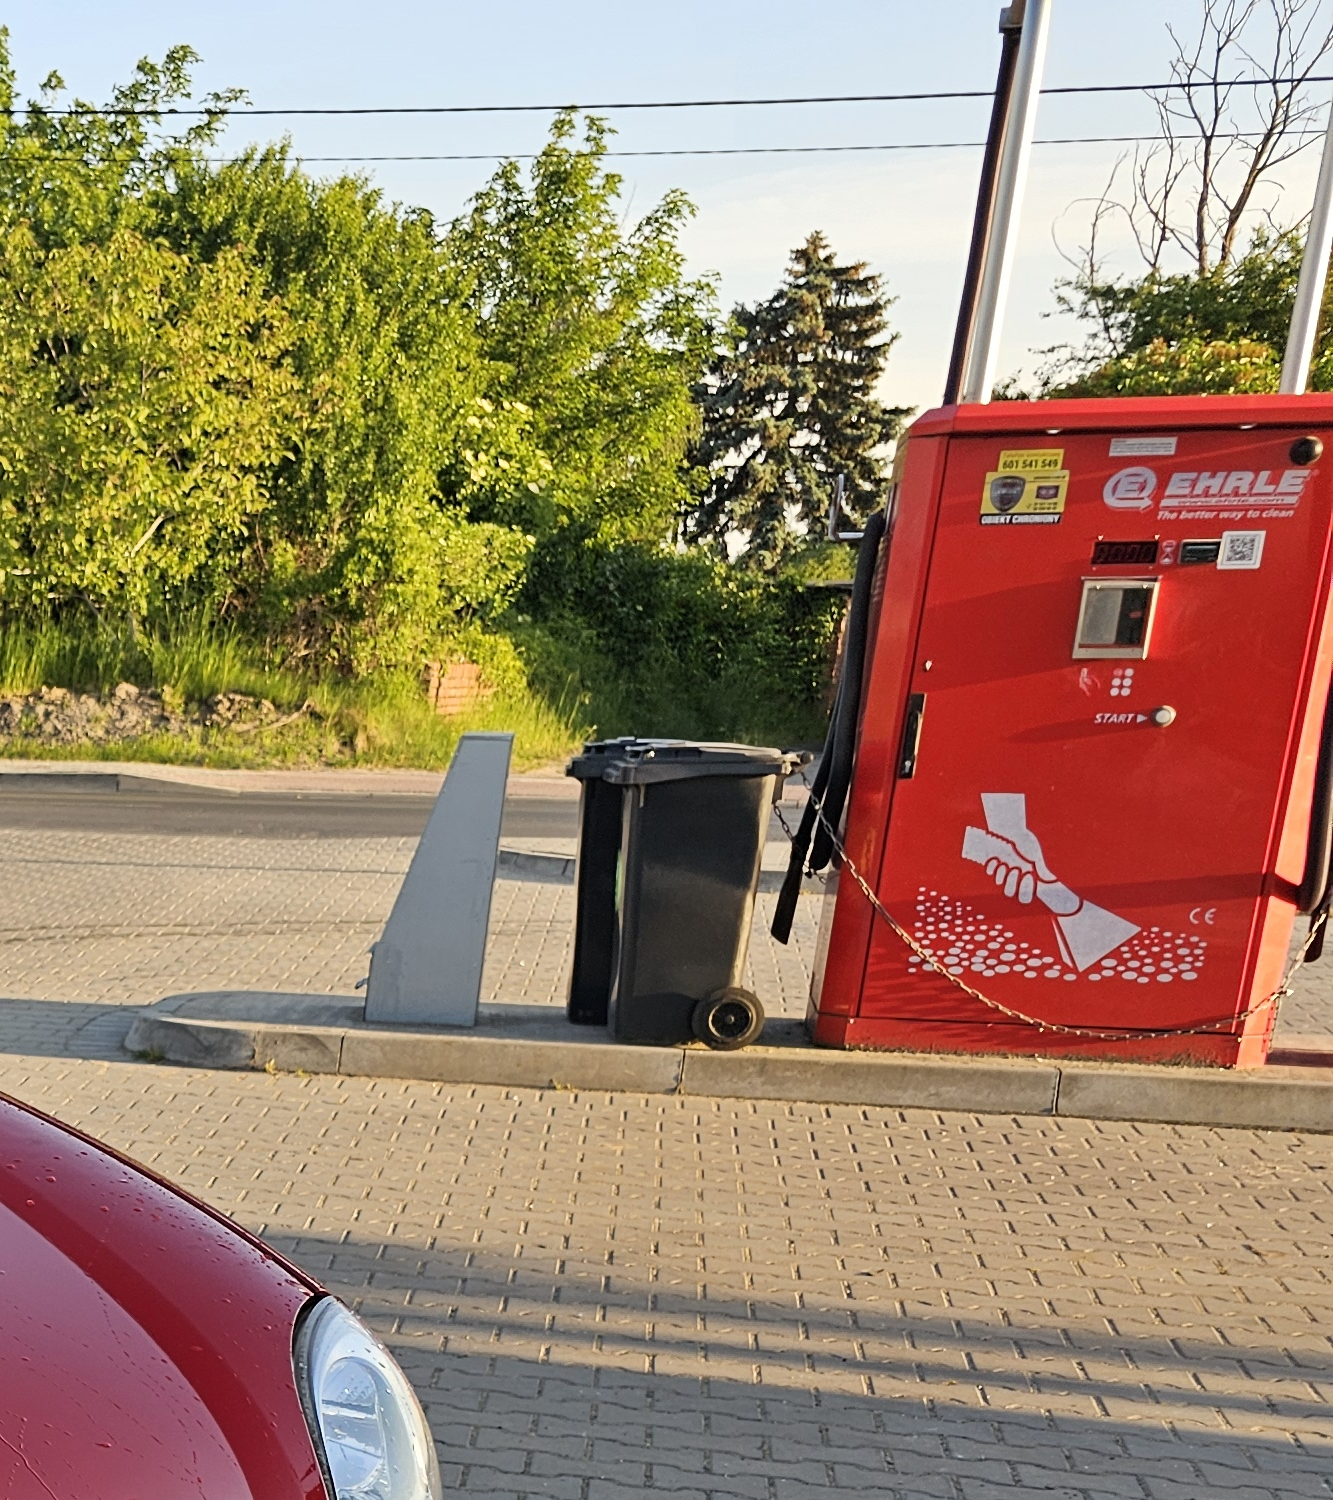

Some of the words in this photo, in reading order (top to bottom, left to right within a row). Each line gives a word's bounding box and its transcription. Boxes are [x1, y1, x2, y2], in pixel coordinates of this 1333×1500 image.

[1002, 459, 1019, 469] 601
[1021, 459, 1039, 469] 541
[1040, 458, 1059, 468] 549
[1164, 469, 1312, 495] EHRLE
[1157, 510, 1178, 520] The
[1179, 510, 1218, 520] better
[1218, 511, 1245, 521] way
[1246, 509, 1261, 519] to
[1261, 508, 1295, 518] clean
[1094, 712, 1135, 724] START
